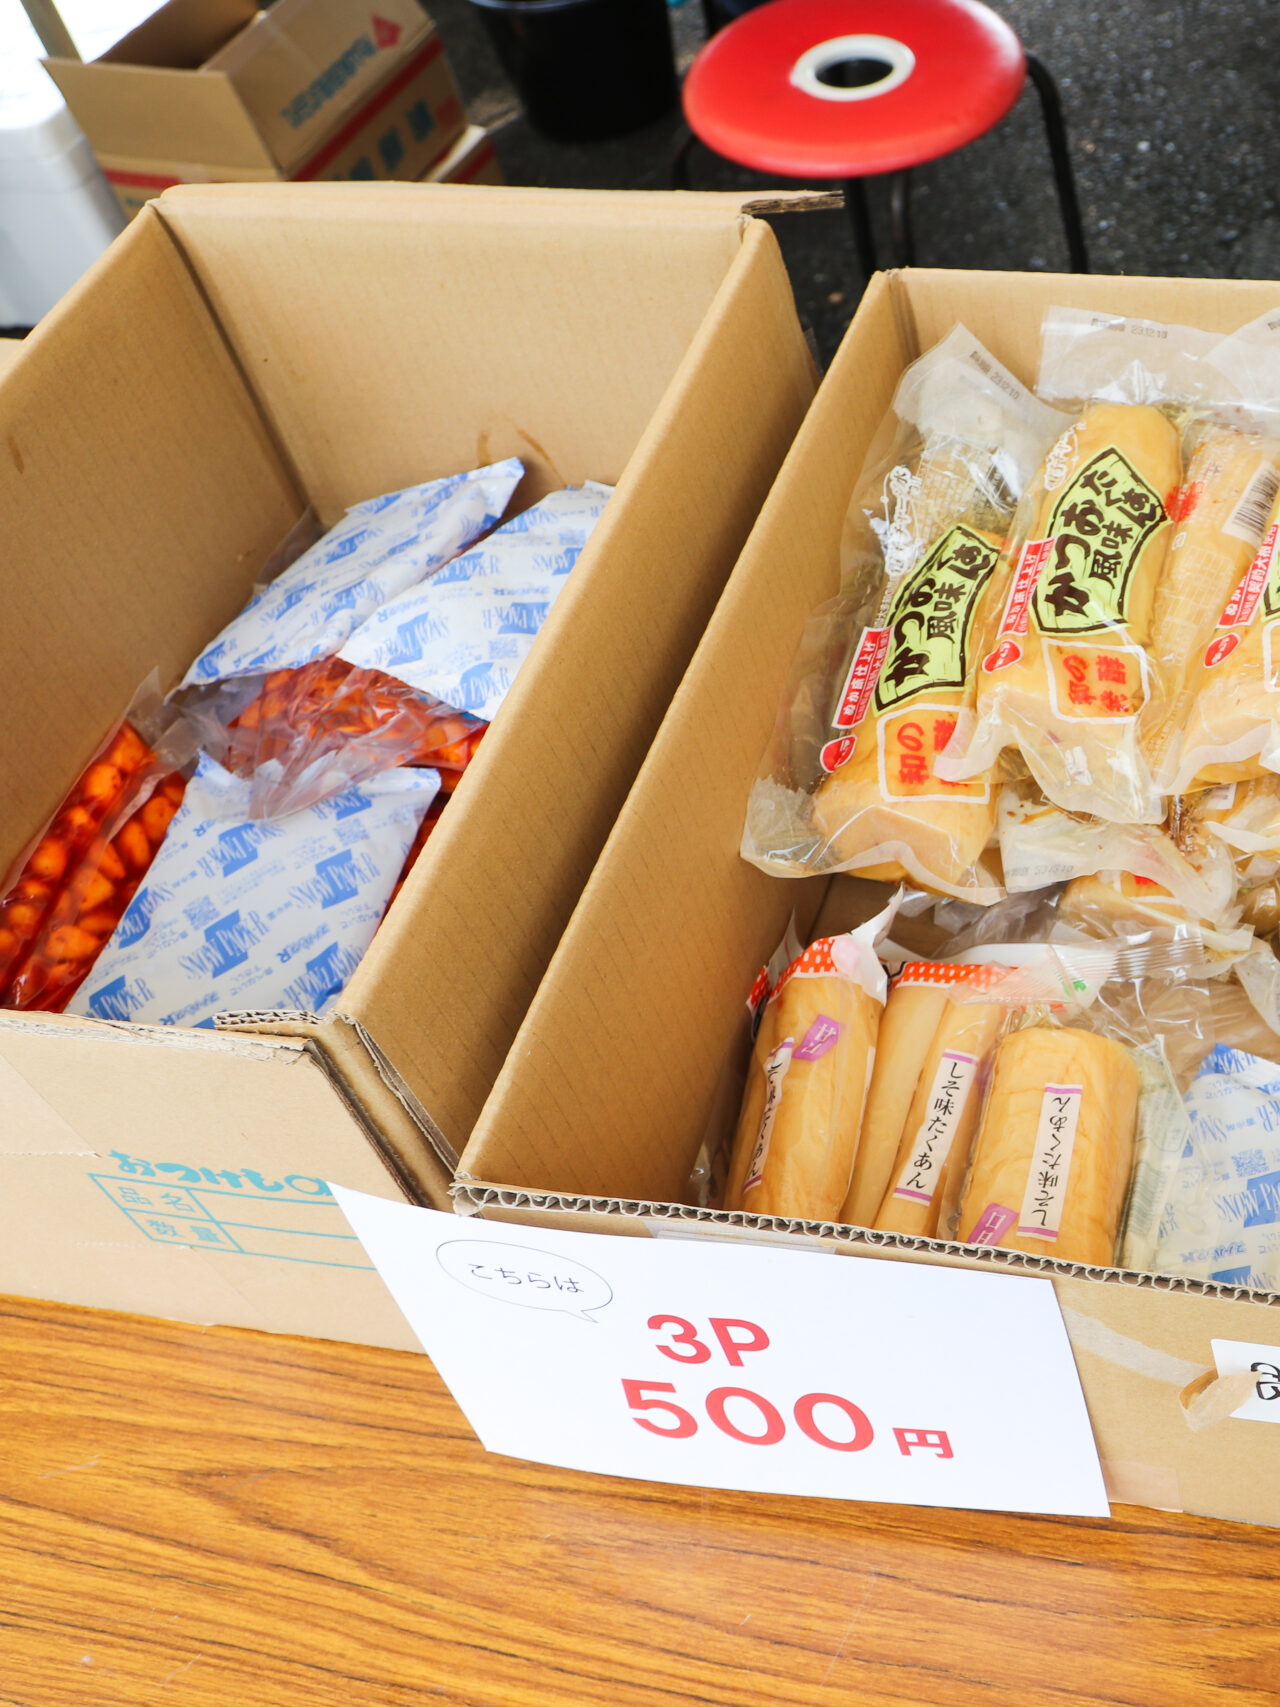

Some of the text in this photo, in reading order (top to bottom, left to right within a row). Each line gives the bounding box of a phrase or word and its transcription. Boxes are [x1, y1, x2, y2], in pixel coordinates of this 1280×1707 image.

[1044, 500, 1105, 618] かつお
[1090, 519, 1134, 588] 風味
[927, 582, 966, 640] 風味
[1064, 654, 1096, 707] 和の
[897, 721, 930, 786] 和の
[175, 906, 275, 984] SNOW PACK-R
[905, 1062, 964, 1190] しそ味たくあん
[1033, 1096, 1072, 1228] しそ味たくあん
[118, 1185, 196, 1214] 品名
[1213, 1188, 1261, 1225] SNOW
[148, 1218, 228, 1245] 数量
[466, 1261, 585, 1294] こちらは
[646, 1313, 771, 1368] 3P
